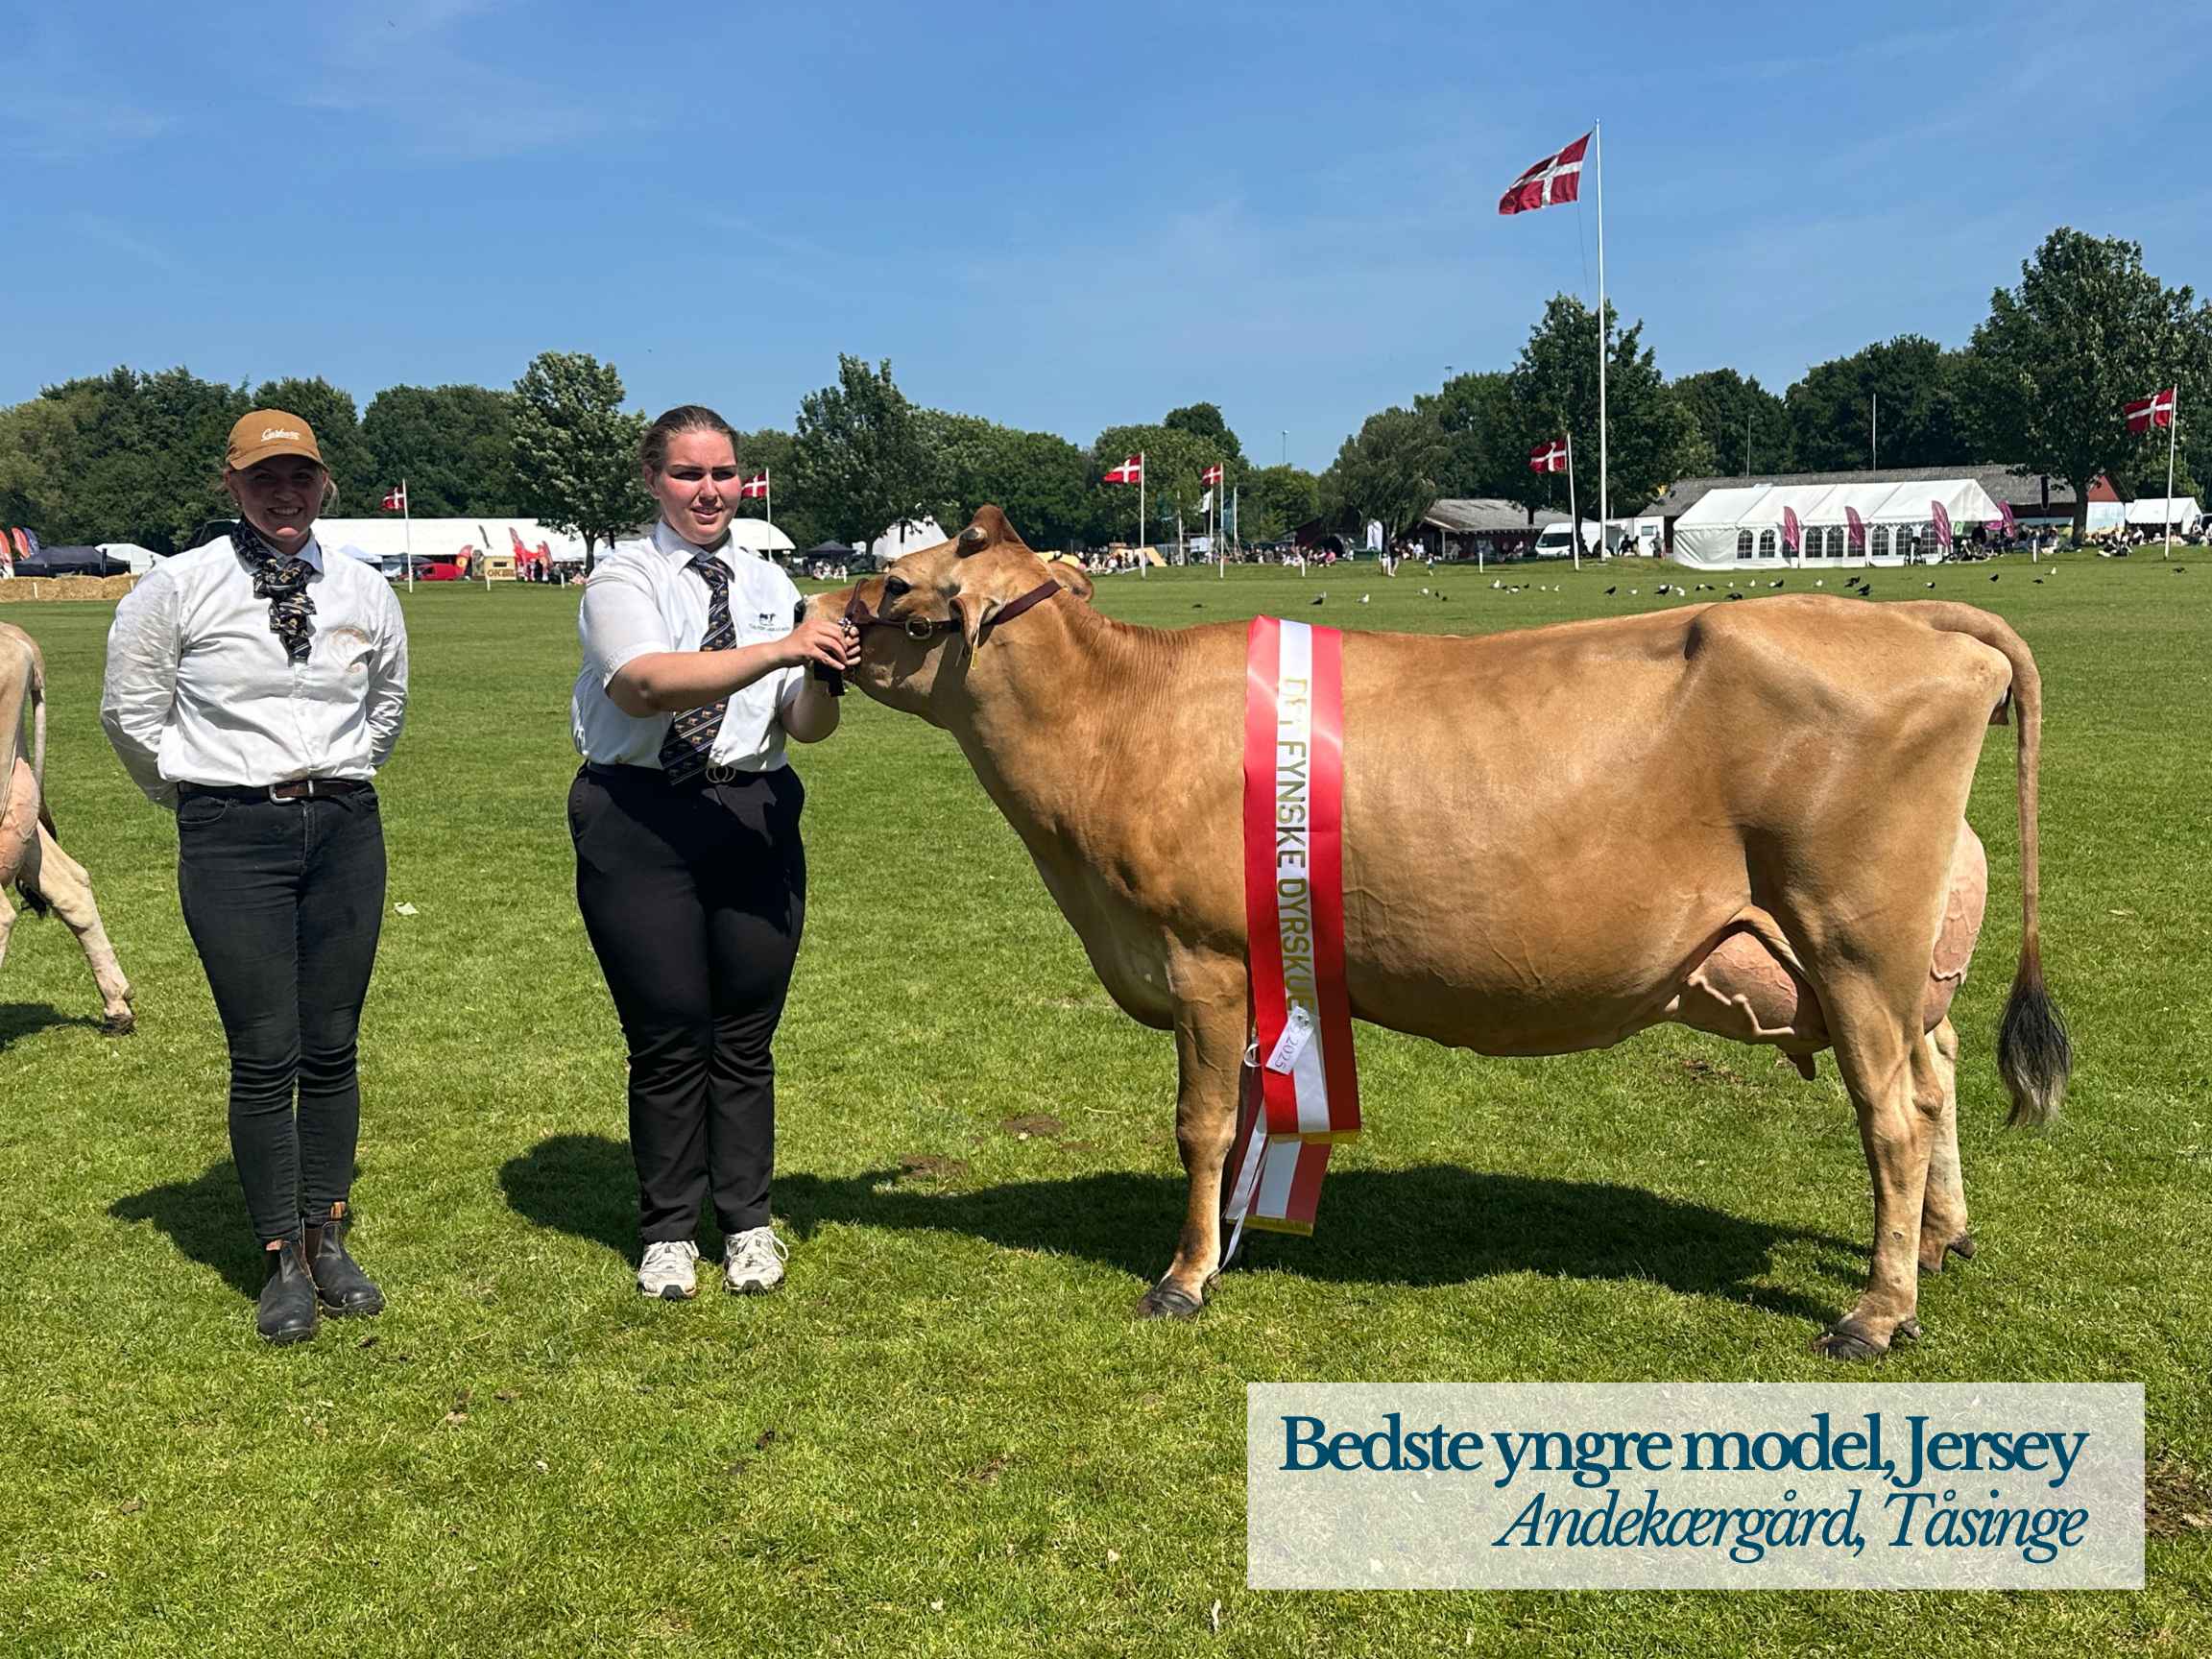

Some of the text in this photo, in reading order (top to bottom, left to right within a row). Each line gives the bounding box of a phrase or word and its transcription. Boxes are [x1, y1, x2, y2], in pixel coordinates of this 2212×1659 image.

[1277, 740, 1307, 869] FYNSKE
[1278, 878, 1314, 1014] DYRSKUE
[1275, 1037, 1299, 1070] 2025
